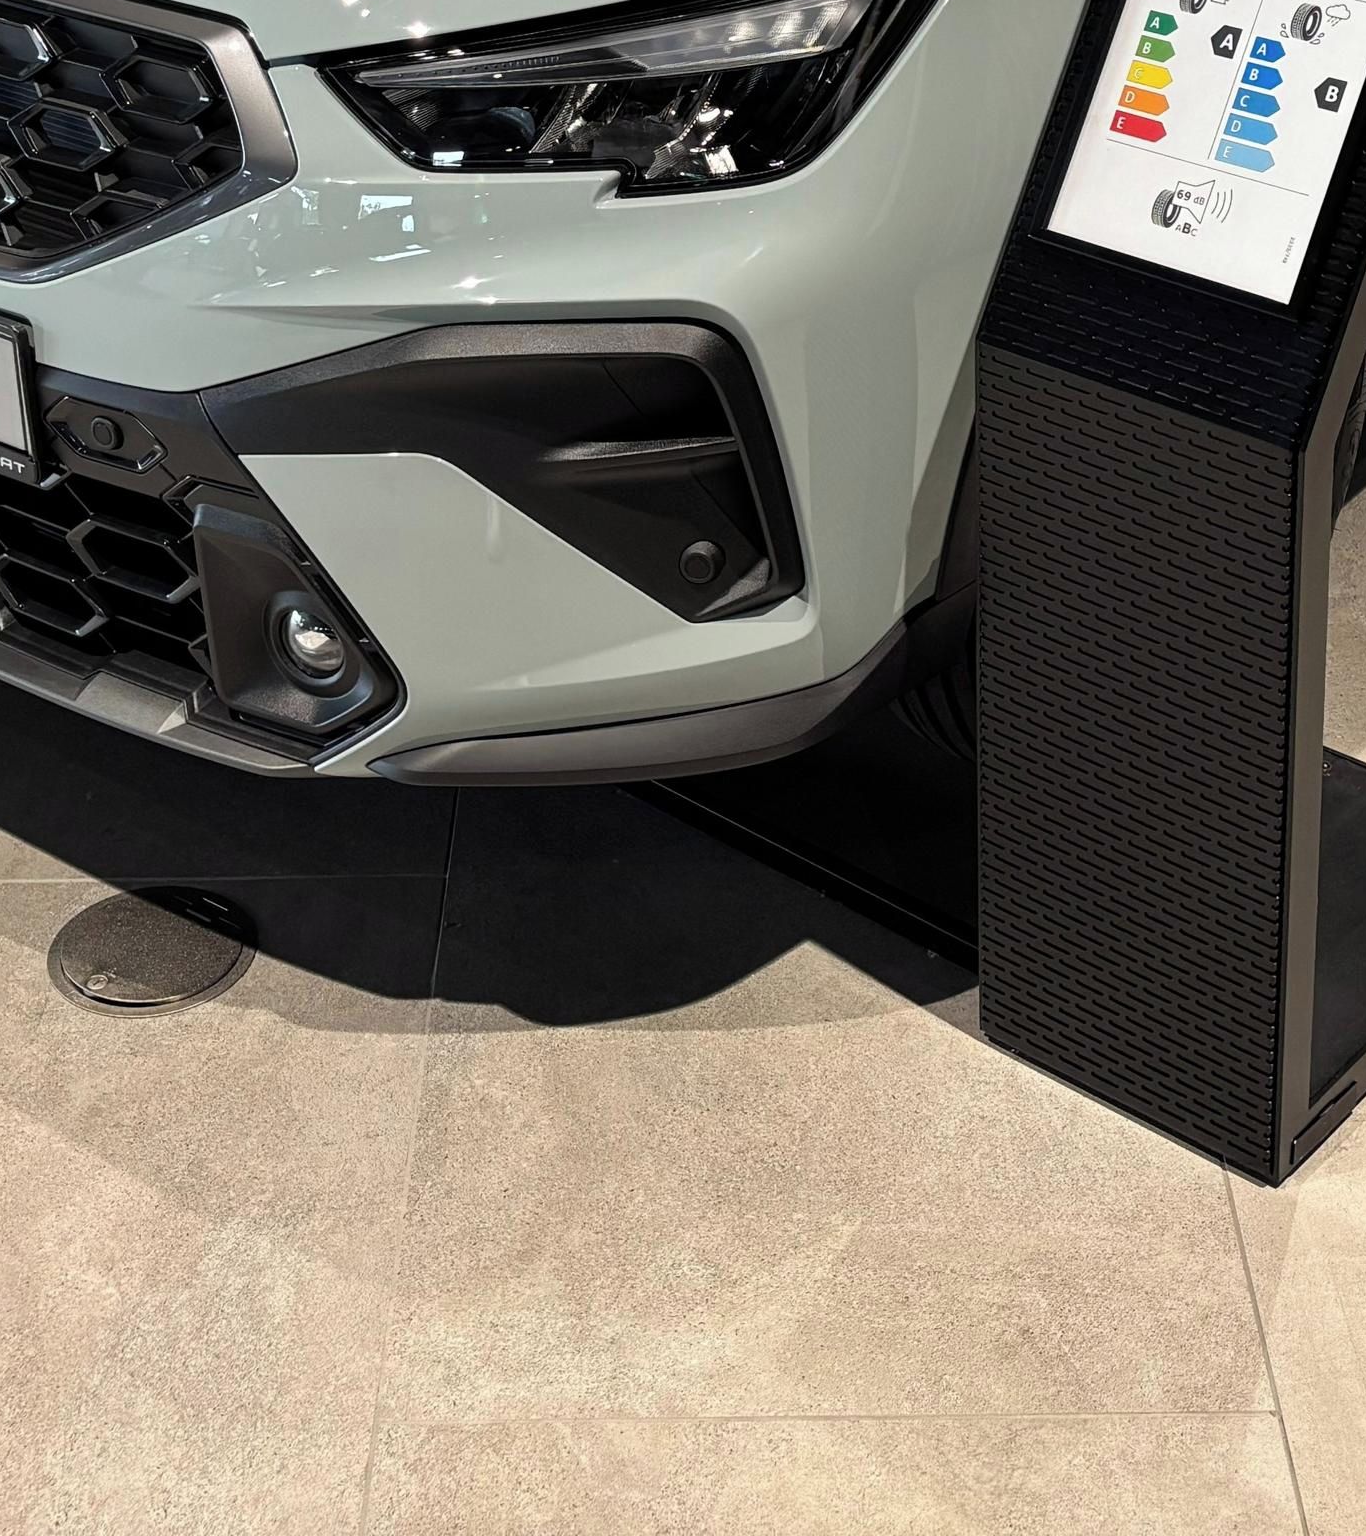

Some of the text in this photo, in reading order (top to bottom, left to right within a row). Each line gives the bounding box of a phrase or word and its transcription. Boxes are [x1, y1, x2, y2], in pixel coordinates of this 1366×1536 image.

[1149, 16, 1160, 29] A
[1142, 41, 1152, 54] B
[1219, 33, 1233, 51] A
[1256, 42, 1267, 56] A
[1134, 67, 1144, 80] C
[1249, 68, 1259, 81] B
[1124, 90, 1135, 103] D
[1325, 85, 1339, 102] B
[1240, 95, 1250, 108] C
[1116, 116, 1126, 129] E
[1231, 120, 1241, 133] D
[1223, 146, 1233, 158] E
[1177, 189, 1205, 206] 69 dB
[1175, 222, 1199, 237] ABC
